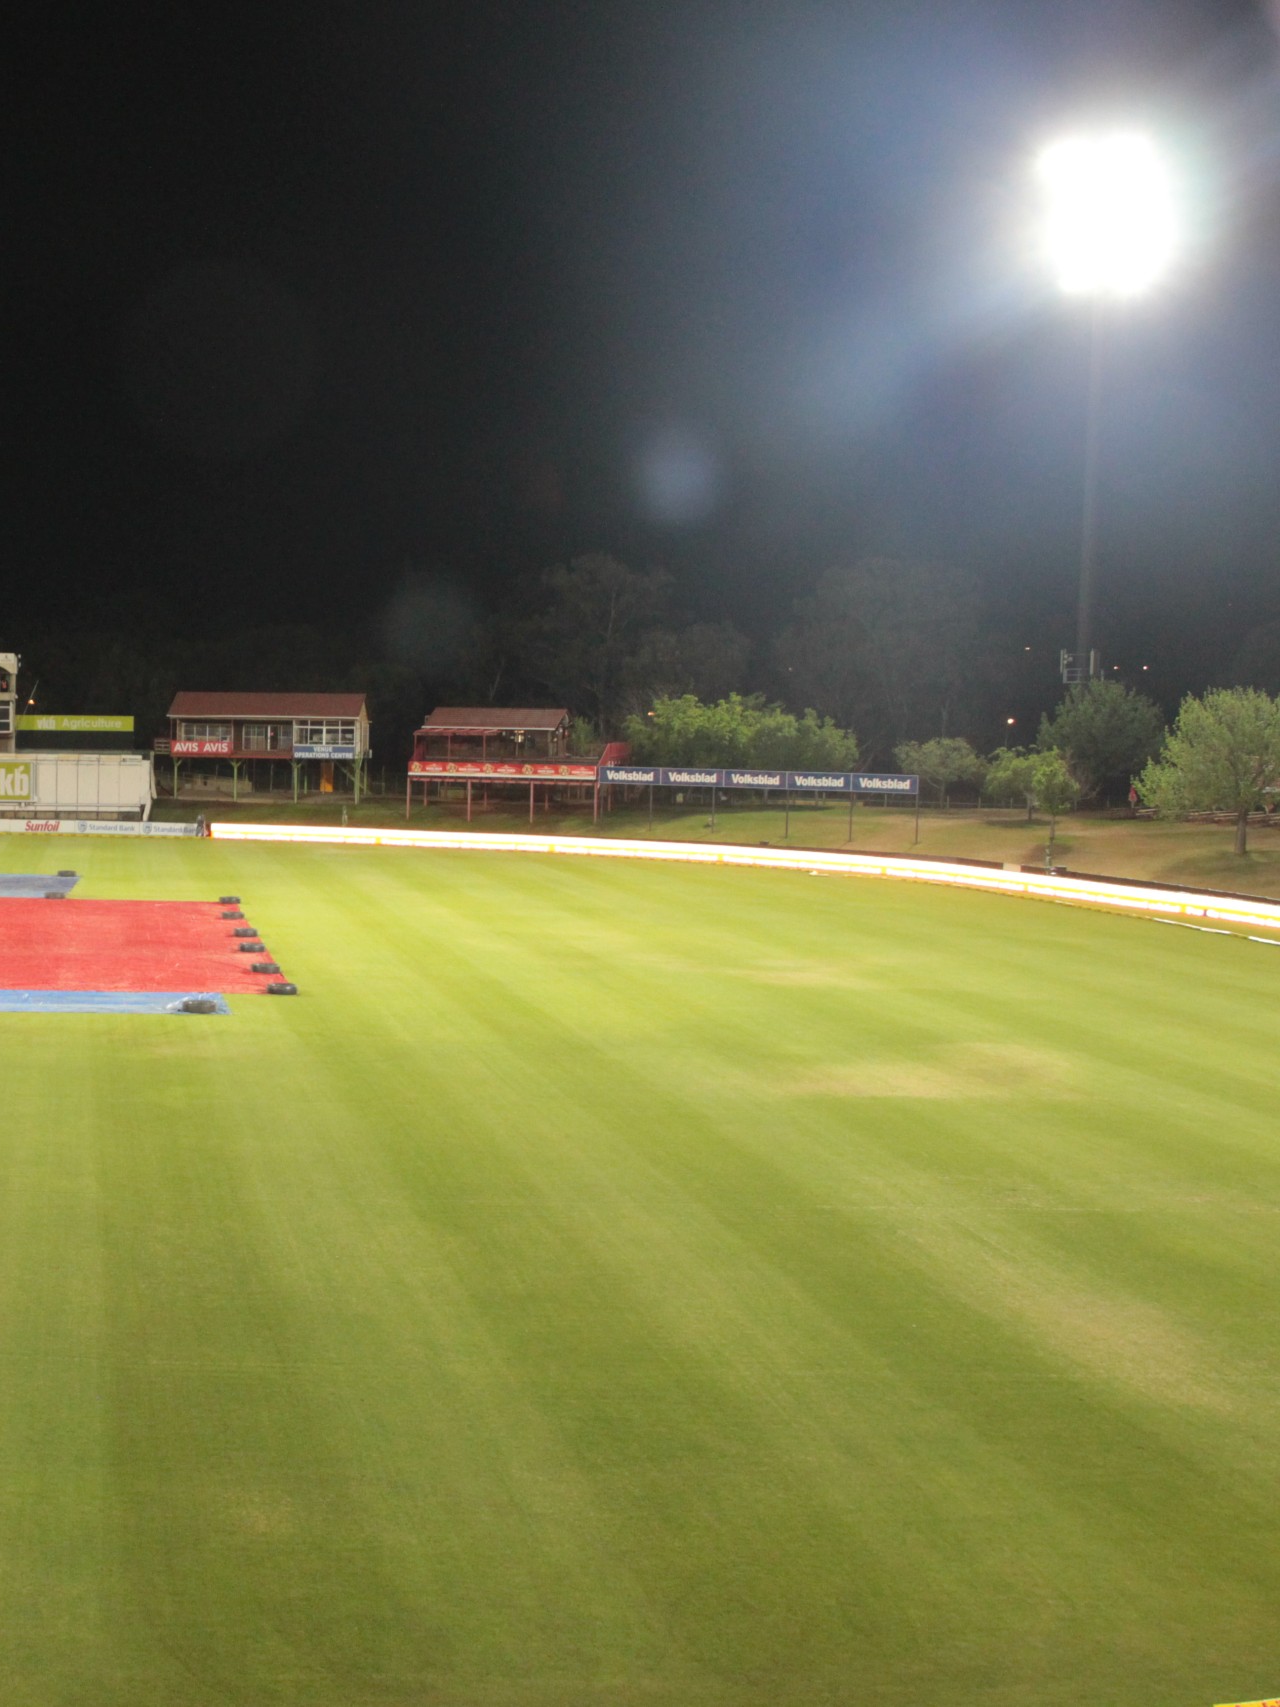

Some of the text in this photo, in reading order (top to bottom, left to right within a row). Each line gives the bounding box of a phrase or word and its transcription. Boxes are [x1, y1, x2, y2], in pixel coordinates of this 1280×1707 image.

[62, 716, 123, 729] Agriculture
[174, 742, 229, 753] AVIS AVIS
[606, 769, 654, 783] Volksblad
[668, 771, 717, 784] Volksblad
[731, 773, 780, 786] Volksblad
[794, 775, 844, 788] Volksblad
[859, 777, 910, 790] Volksblad
[24, 820, 61, 833] Sunfoil
[89, 823, 135, 832] Standard Bank
